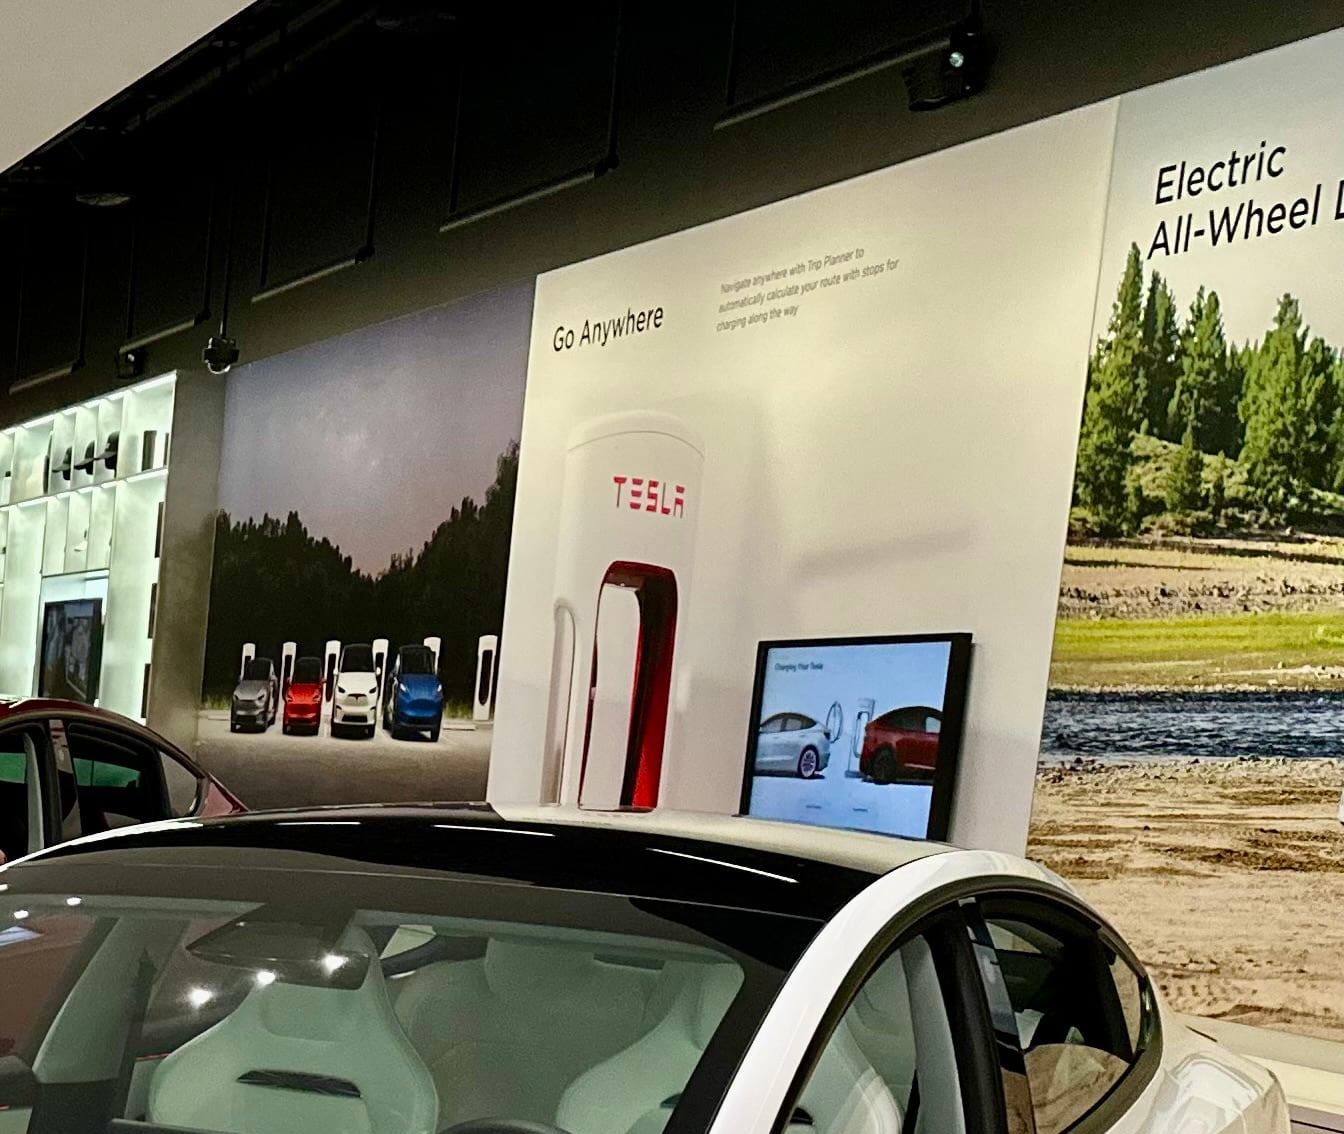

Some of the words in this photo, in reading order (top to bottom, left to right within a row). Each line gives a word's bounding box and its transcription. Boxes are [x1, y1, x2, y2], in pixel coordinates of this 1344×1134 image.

[1155, 140, 1287, 205] Electric
[1147, 183, 1322, 260] All-Wheel
[718, 292, 765, 313] automatically
[766, 283, 800, 301] calculate
[800, 279, 820, 296] your
[820, 274, 841, 288] route
[843, 268, 861, 282] with
[862, 260, 885, 278] stops
[886, 258, 900, 271] for
[720, 278, 752, 294] Navigate
[752, 268, 787, 286] anywhere
[789, 263, 806, 276] with
[808, 259, 822, 272] Trip
[823, 250, 854, 267] Planner
[855, 248, 865, 259] to
[553, 326, 575, 352] Go
[579, 305, 664, 347] Anywhere
[716, 316, 747, 332] charging
[748, 310, 768, 325] along
[769, 306, 782, 319] the
[783, 304, 800, 317] way
[613, 476, 685, 519] TESLA
